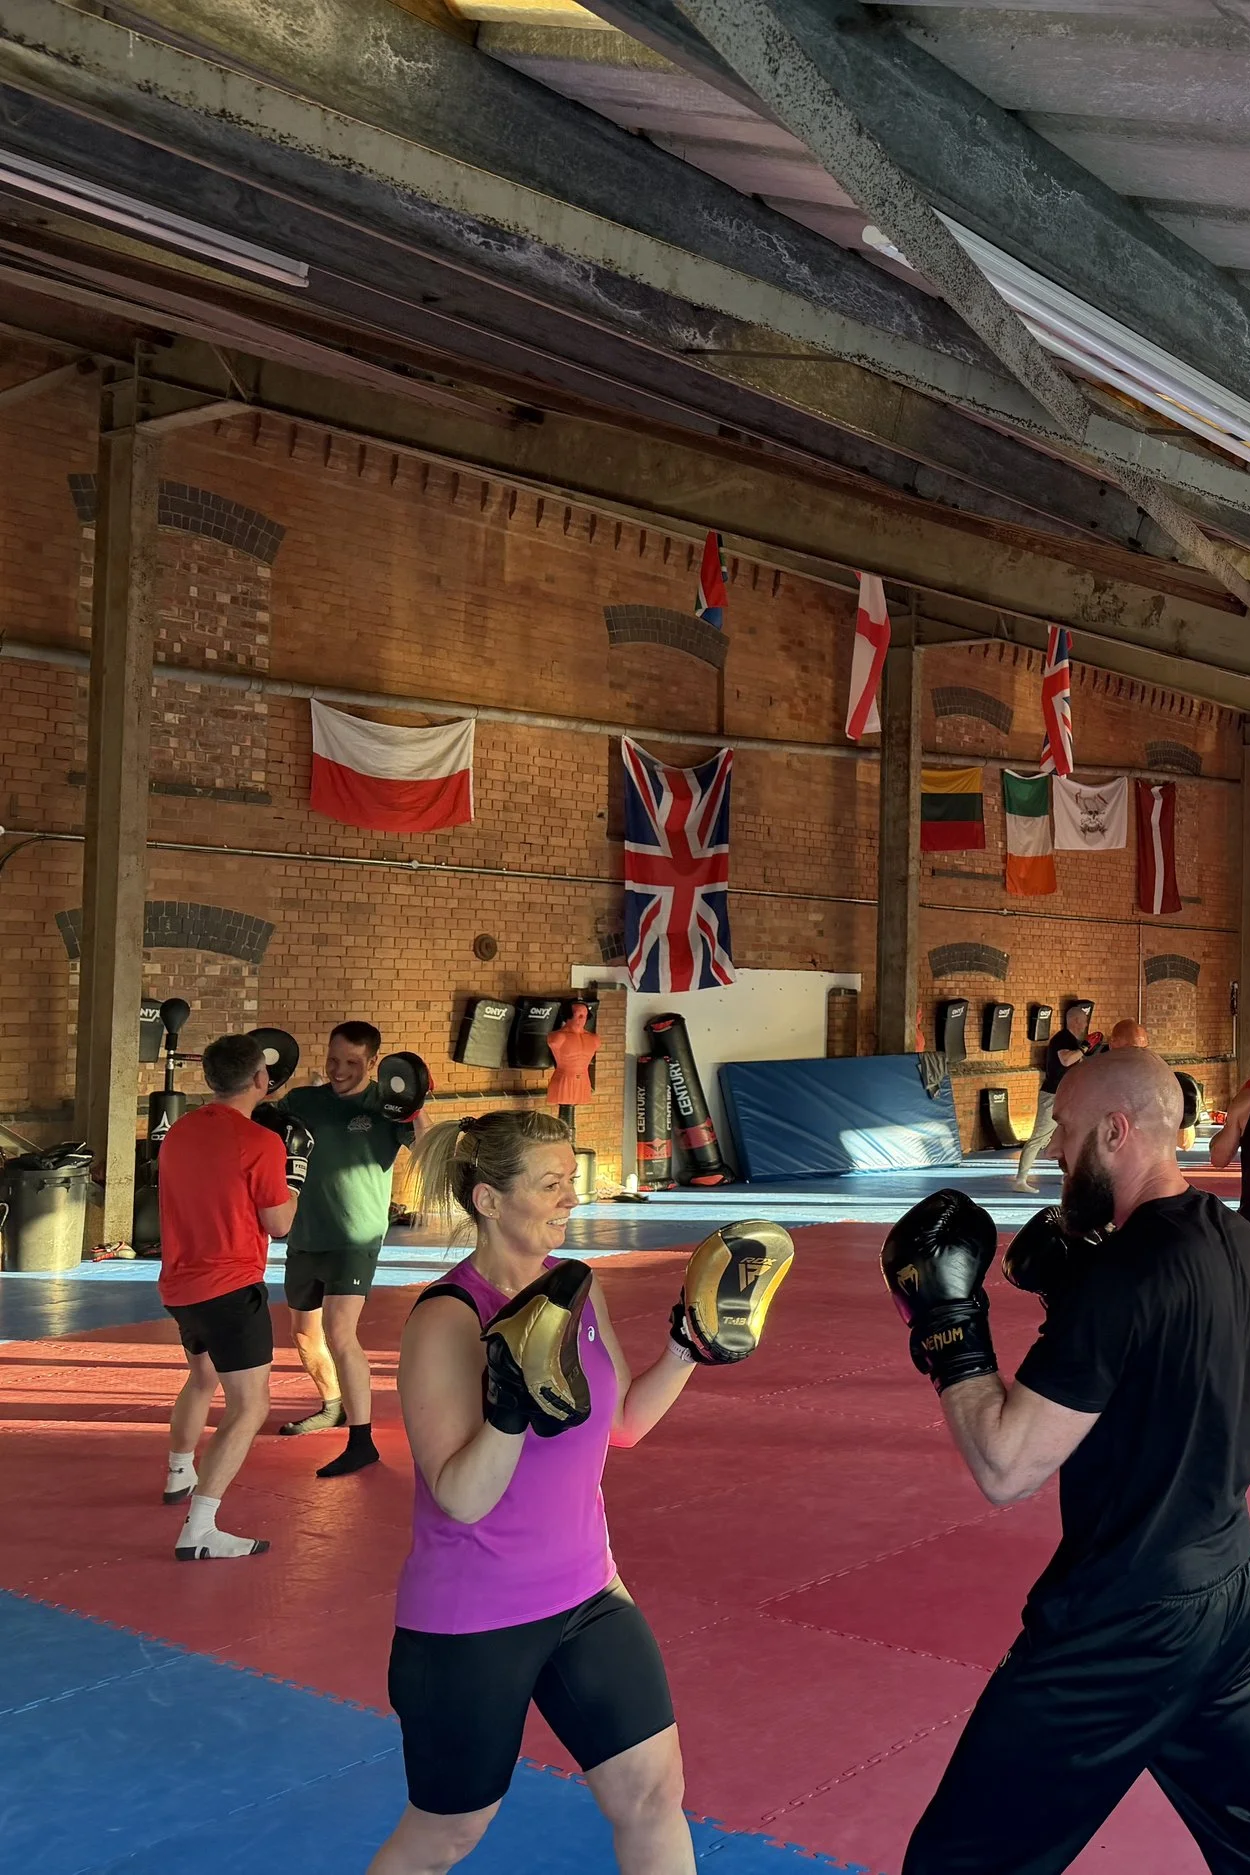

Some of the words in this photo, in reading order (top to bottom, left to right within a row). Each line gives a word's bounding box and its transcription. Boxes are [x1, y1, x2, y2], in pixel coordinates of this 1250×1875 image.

[140, 1008, 161, 1019] NYX
[484, 1006, 508, 1019] ONYX
[529, 1006, 553, 1018] ONYX
[669, 1061, 694, 1116] CENTURY
[637, 1086, 646, 1133] CENTURY
[920, 1326, 965, 1352] VENUM
